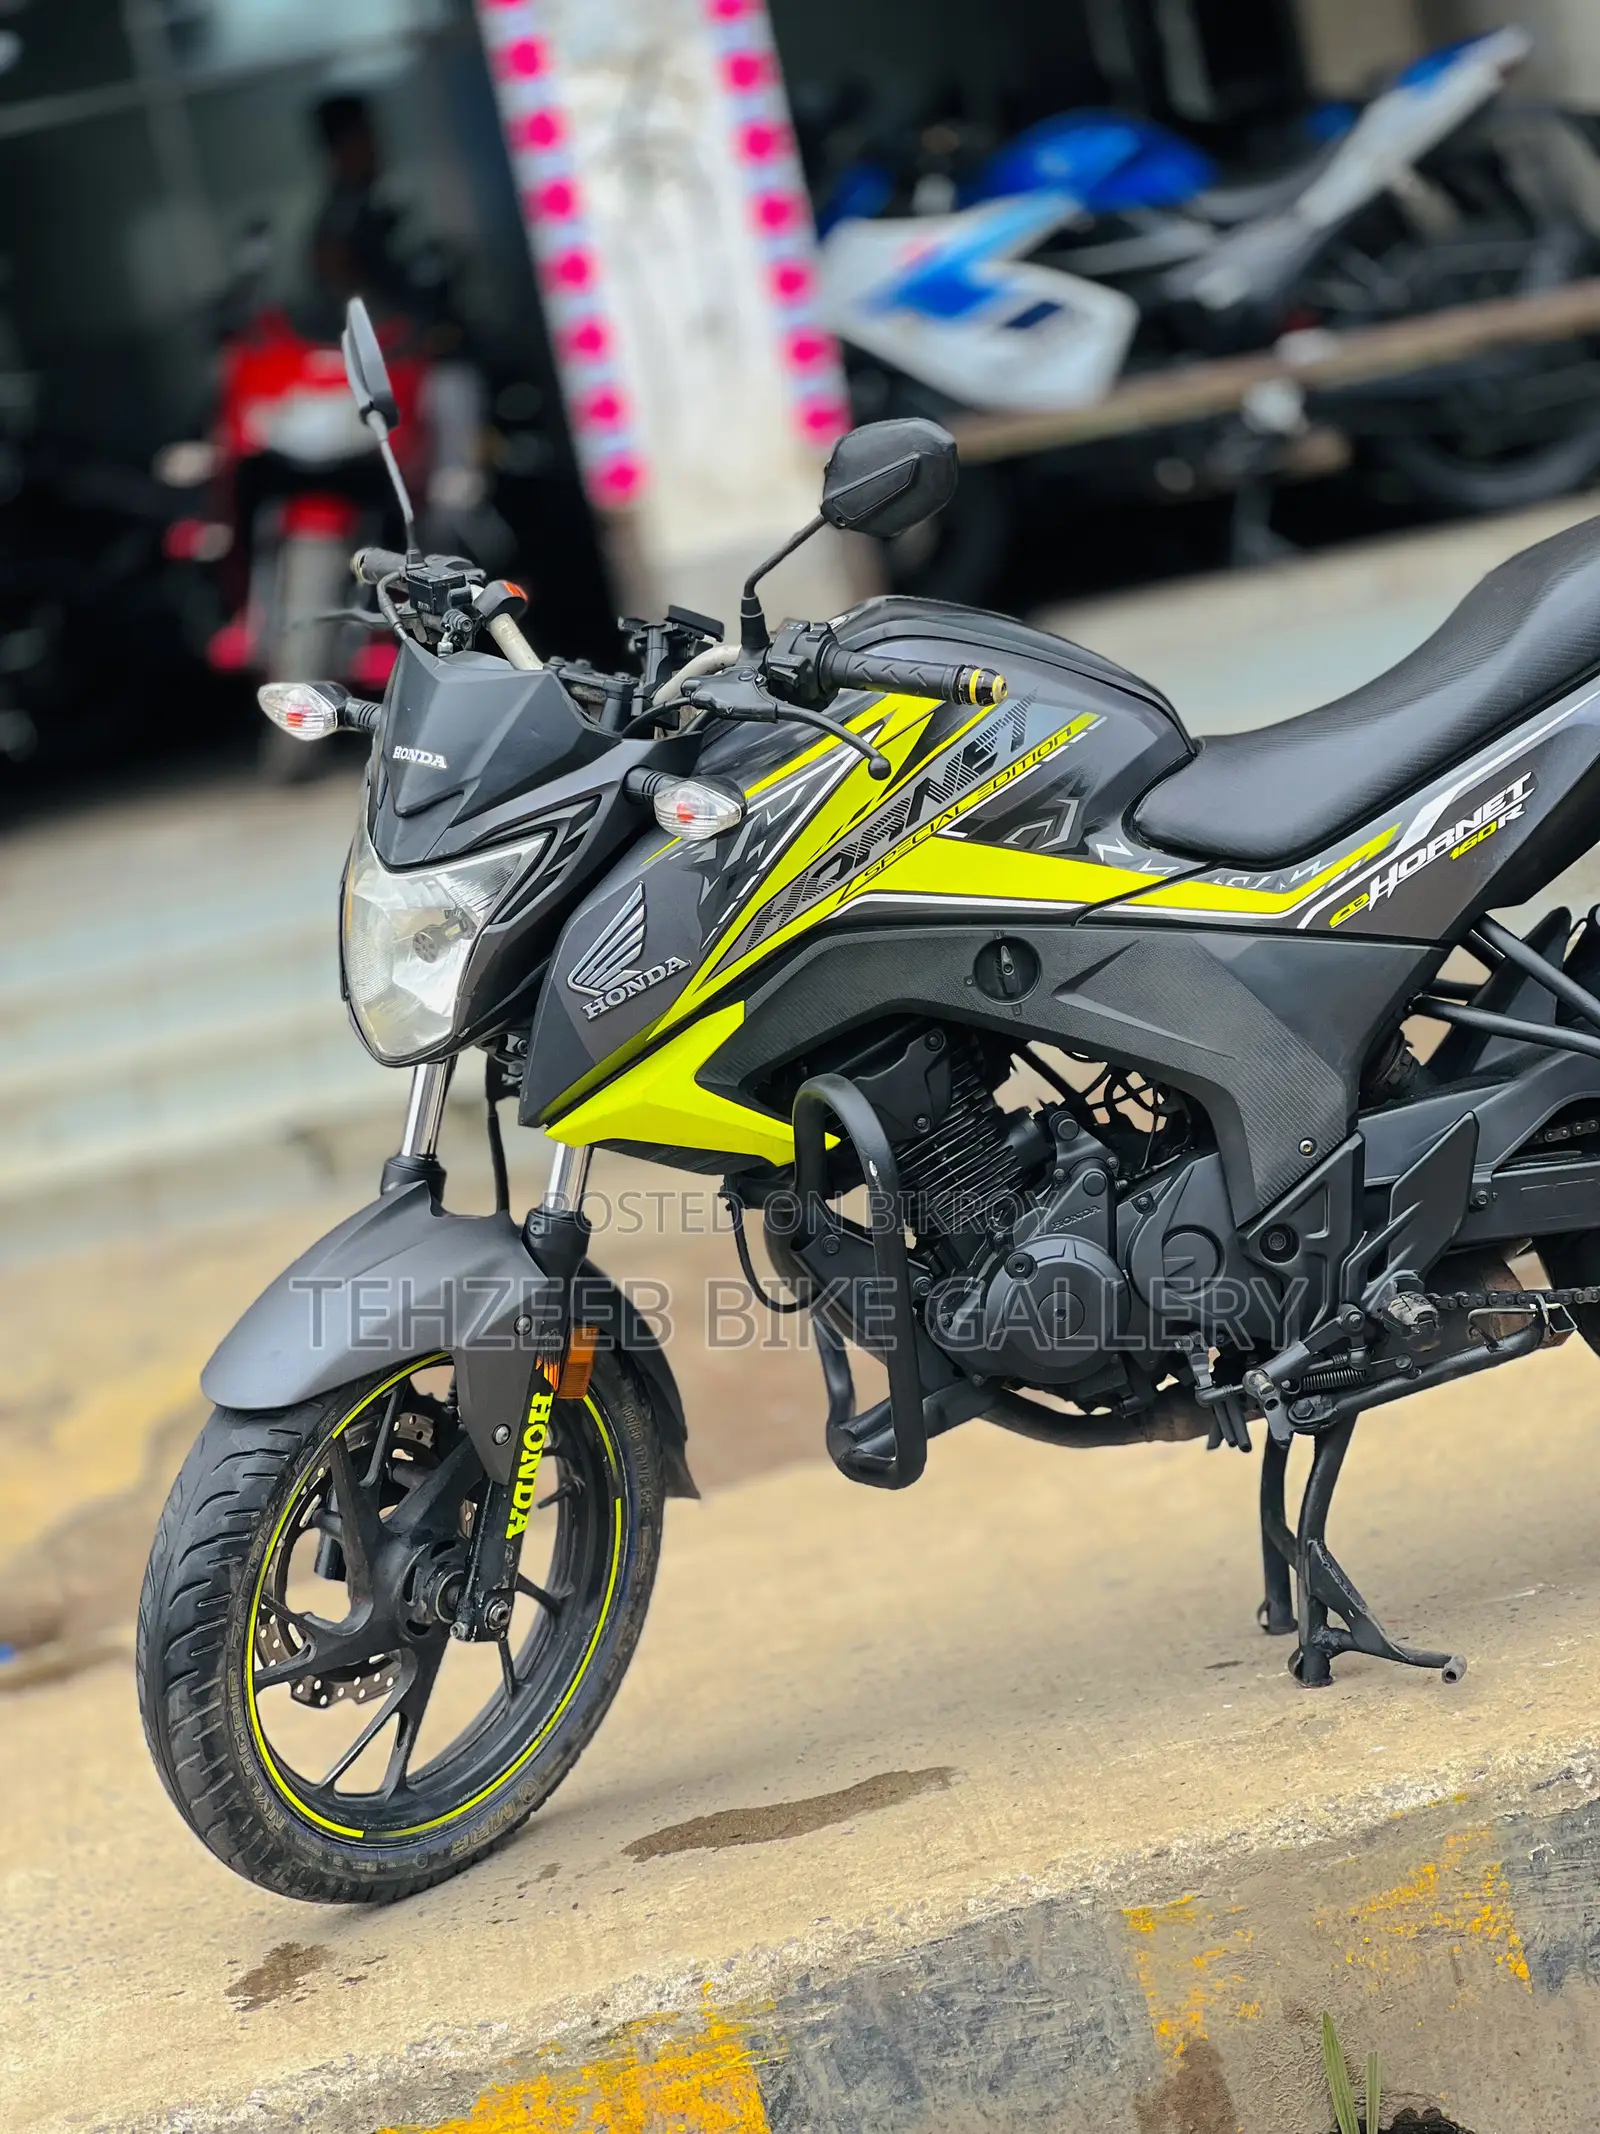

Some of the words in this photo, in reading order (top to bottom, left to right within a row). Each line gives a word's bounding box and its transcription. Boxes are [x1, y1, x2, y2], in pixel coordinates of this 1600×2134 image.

[392, 745, 448, 769] HONDA
[864, 804, 971, 881] SPECIAL
[976, 724, 1073, 802] EDITION
[1449, 803, 1526, 860] 160R
[1329, 892, 1370, 928] CB
[1368, 771, 1533, 911] HORNET
[582, 954, 693, 1021] HONDA
[1051, 1205, 1103, 1231] HONDA
[505, 1392, 554, 1540] HONDA
